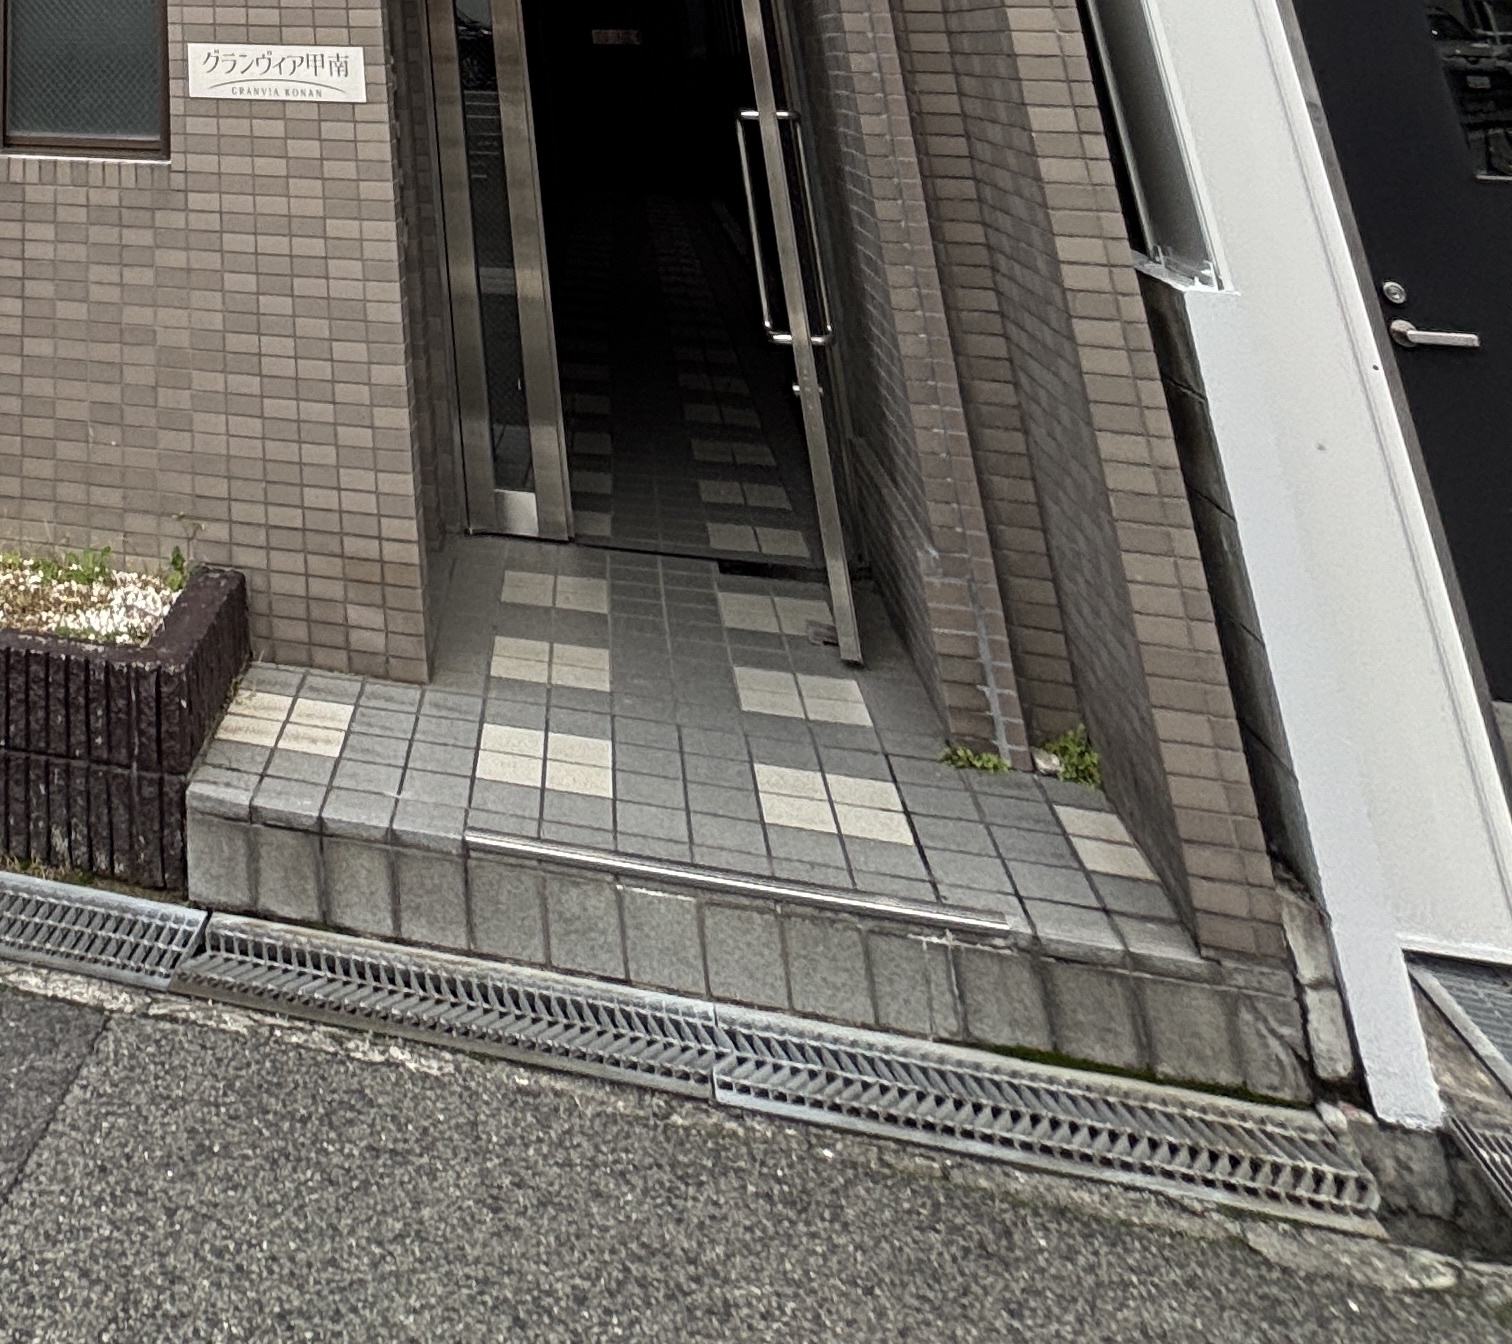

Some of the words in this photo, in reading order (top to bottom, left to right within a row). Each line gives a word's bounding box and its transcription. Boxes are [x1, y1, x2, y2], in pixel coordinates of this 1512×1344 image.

[202, 49, 350, 78] グランヴィア甲南
[231, 86, 280, 97] GRANVIA
[285, 88, 322, 98] KONAN
